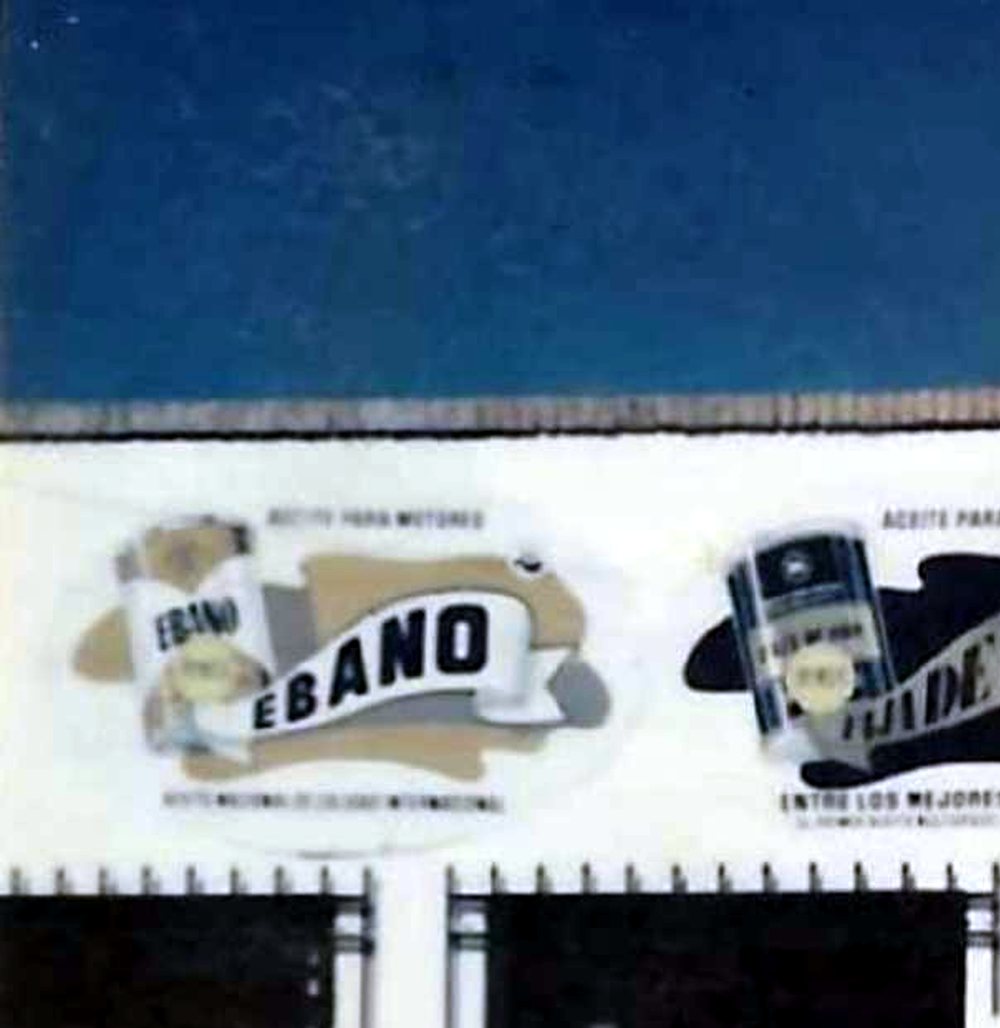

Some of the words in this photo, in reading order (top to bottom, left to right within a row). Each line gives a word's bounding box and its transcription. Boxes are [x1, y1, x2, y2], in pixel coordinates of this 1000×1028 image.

[881, 507, 949, 530] ACEITE
[252, 602, 490, 731] EBANO
[779, 791, 848, 813] ENTRE
[855, 791, 899, 812] LOS
